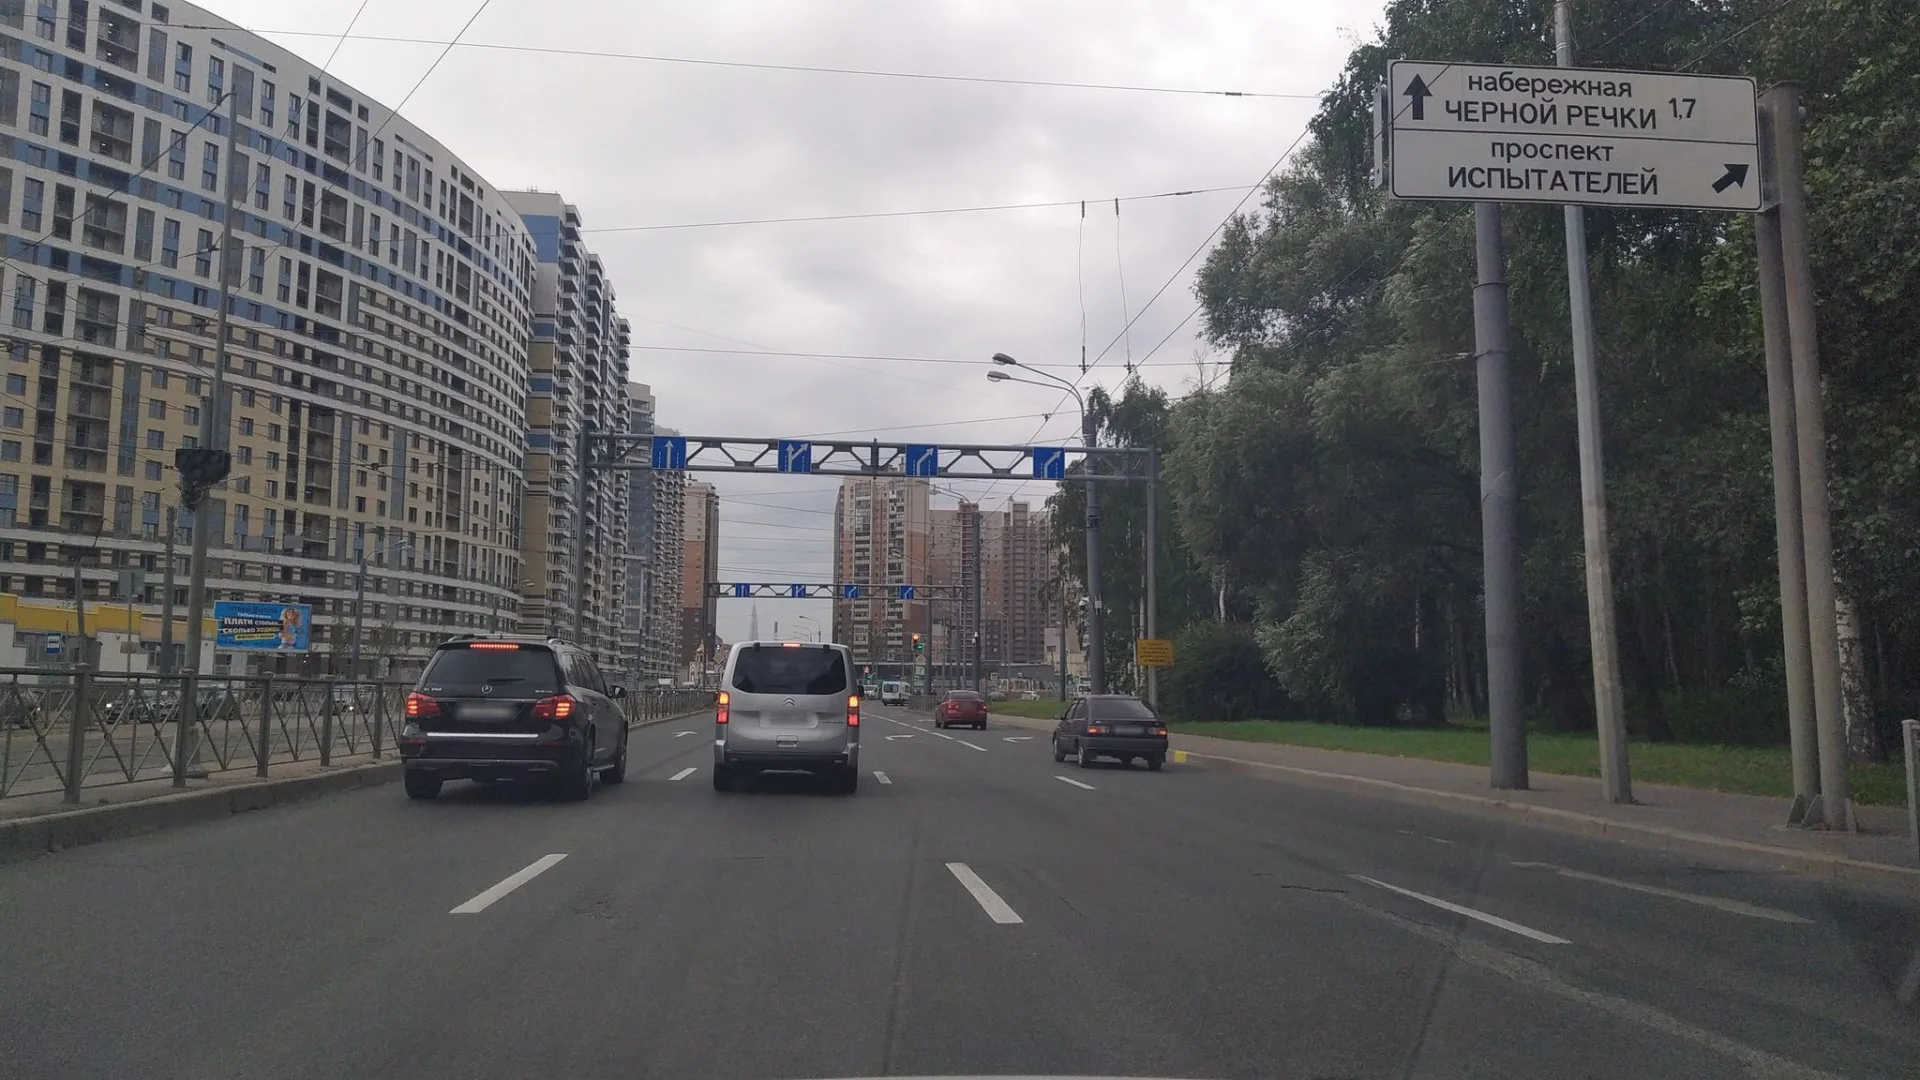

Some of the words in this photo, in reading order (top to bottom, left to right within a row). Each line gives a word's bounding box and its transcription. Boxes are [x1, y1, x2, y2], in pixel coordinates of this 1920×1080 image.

[1468, 71, 1632, 97] набережная
[1445, 99, 1557, 126] ЧЕРНОЙ
[1567, 104, 1657, 129] РЕЧКИ
[1668, 97, 1697, 121] 1,7
[1491, 141, 1614, 163] проспект
[1448, 166, 1658, 195] ИСПЫТАТЕЛЕЙ
[224, 617, 253, 625] ПЛАТИ
